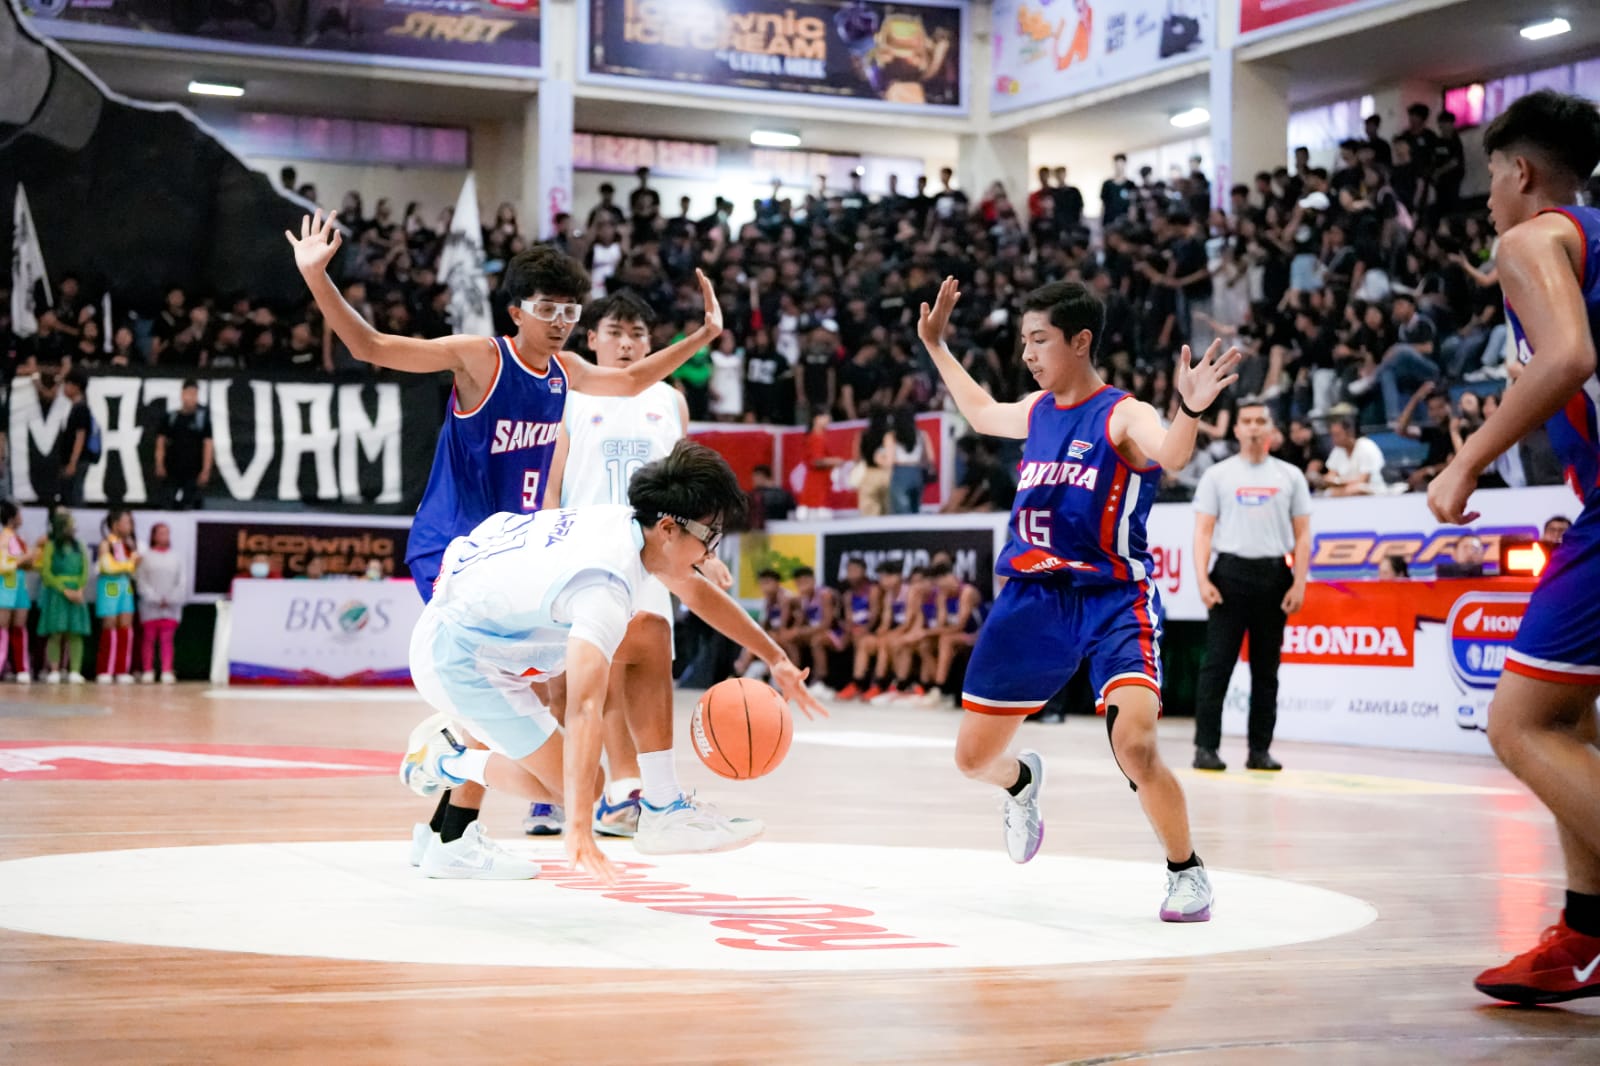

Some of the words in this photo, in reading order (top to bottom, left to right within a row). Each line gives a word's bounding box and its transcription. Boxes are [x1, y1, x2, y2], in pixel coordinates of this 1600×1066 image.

[522, 470, 540, 508] 9
[1016, 461, 1099, 492] AKURA
[1017, 508, 1052, 549] 15
[1151, 546, 1182, 594] ay
[1280, 625, 1408, 656] HONDA
[1482, 615, 1524, 633] HON
